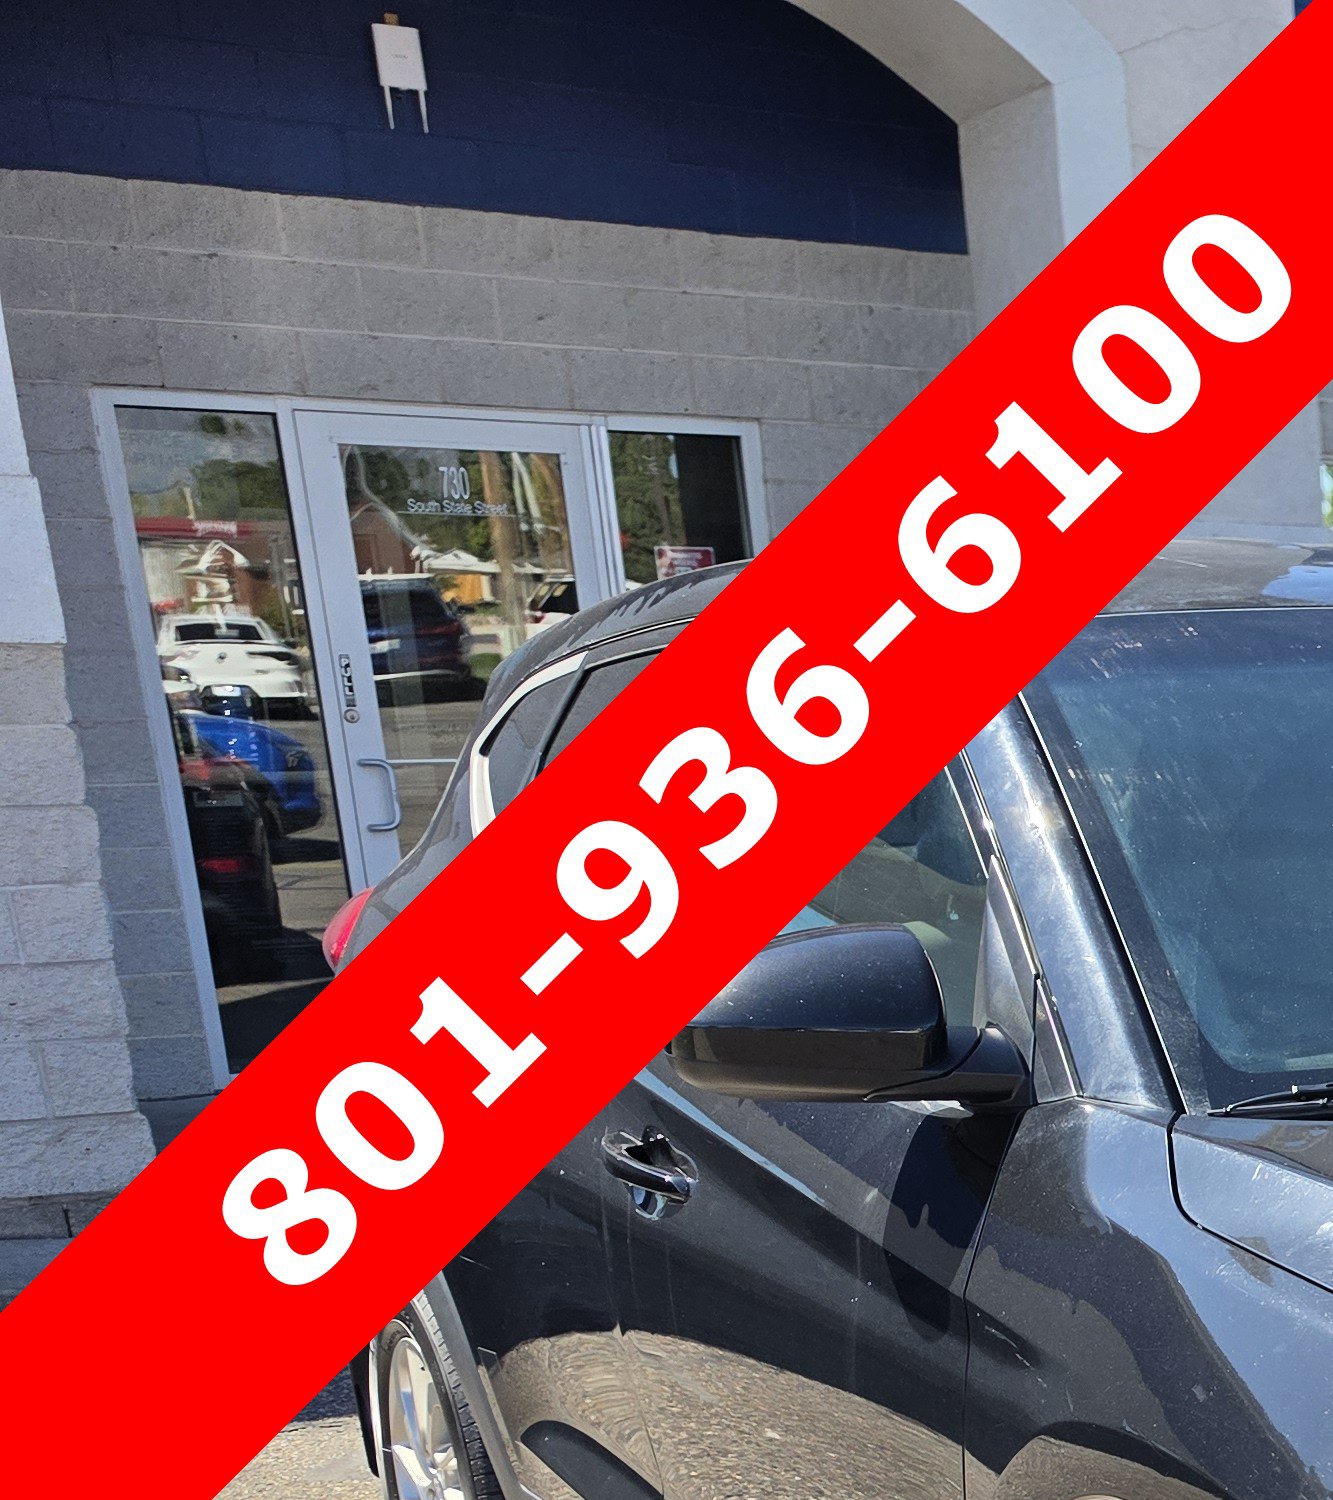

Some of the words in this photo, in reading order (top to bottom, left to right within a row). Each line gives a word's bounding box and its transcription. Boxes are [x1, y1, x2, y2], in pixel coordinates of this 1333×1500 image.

[438, 466, 470, 499] 730
[406, 498, 441, 513] South
[442, 499, 473, 514] State
[340, 657, 354, 696] PULL
